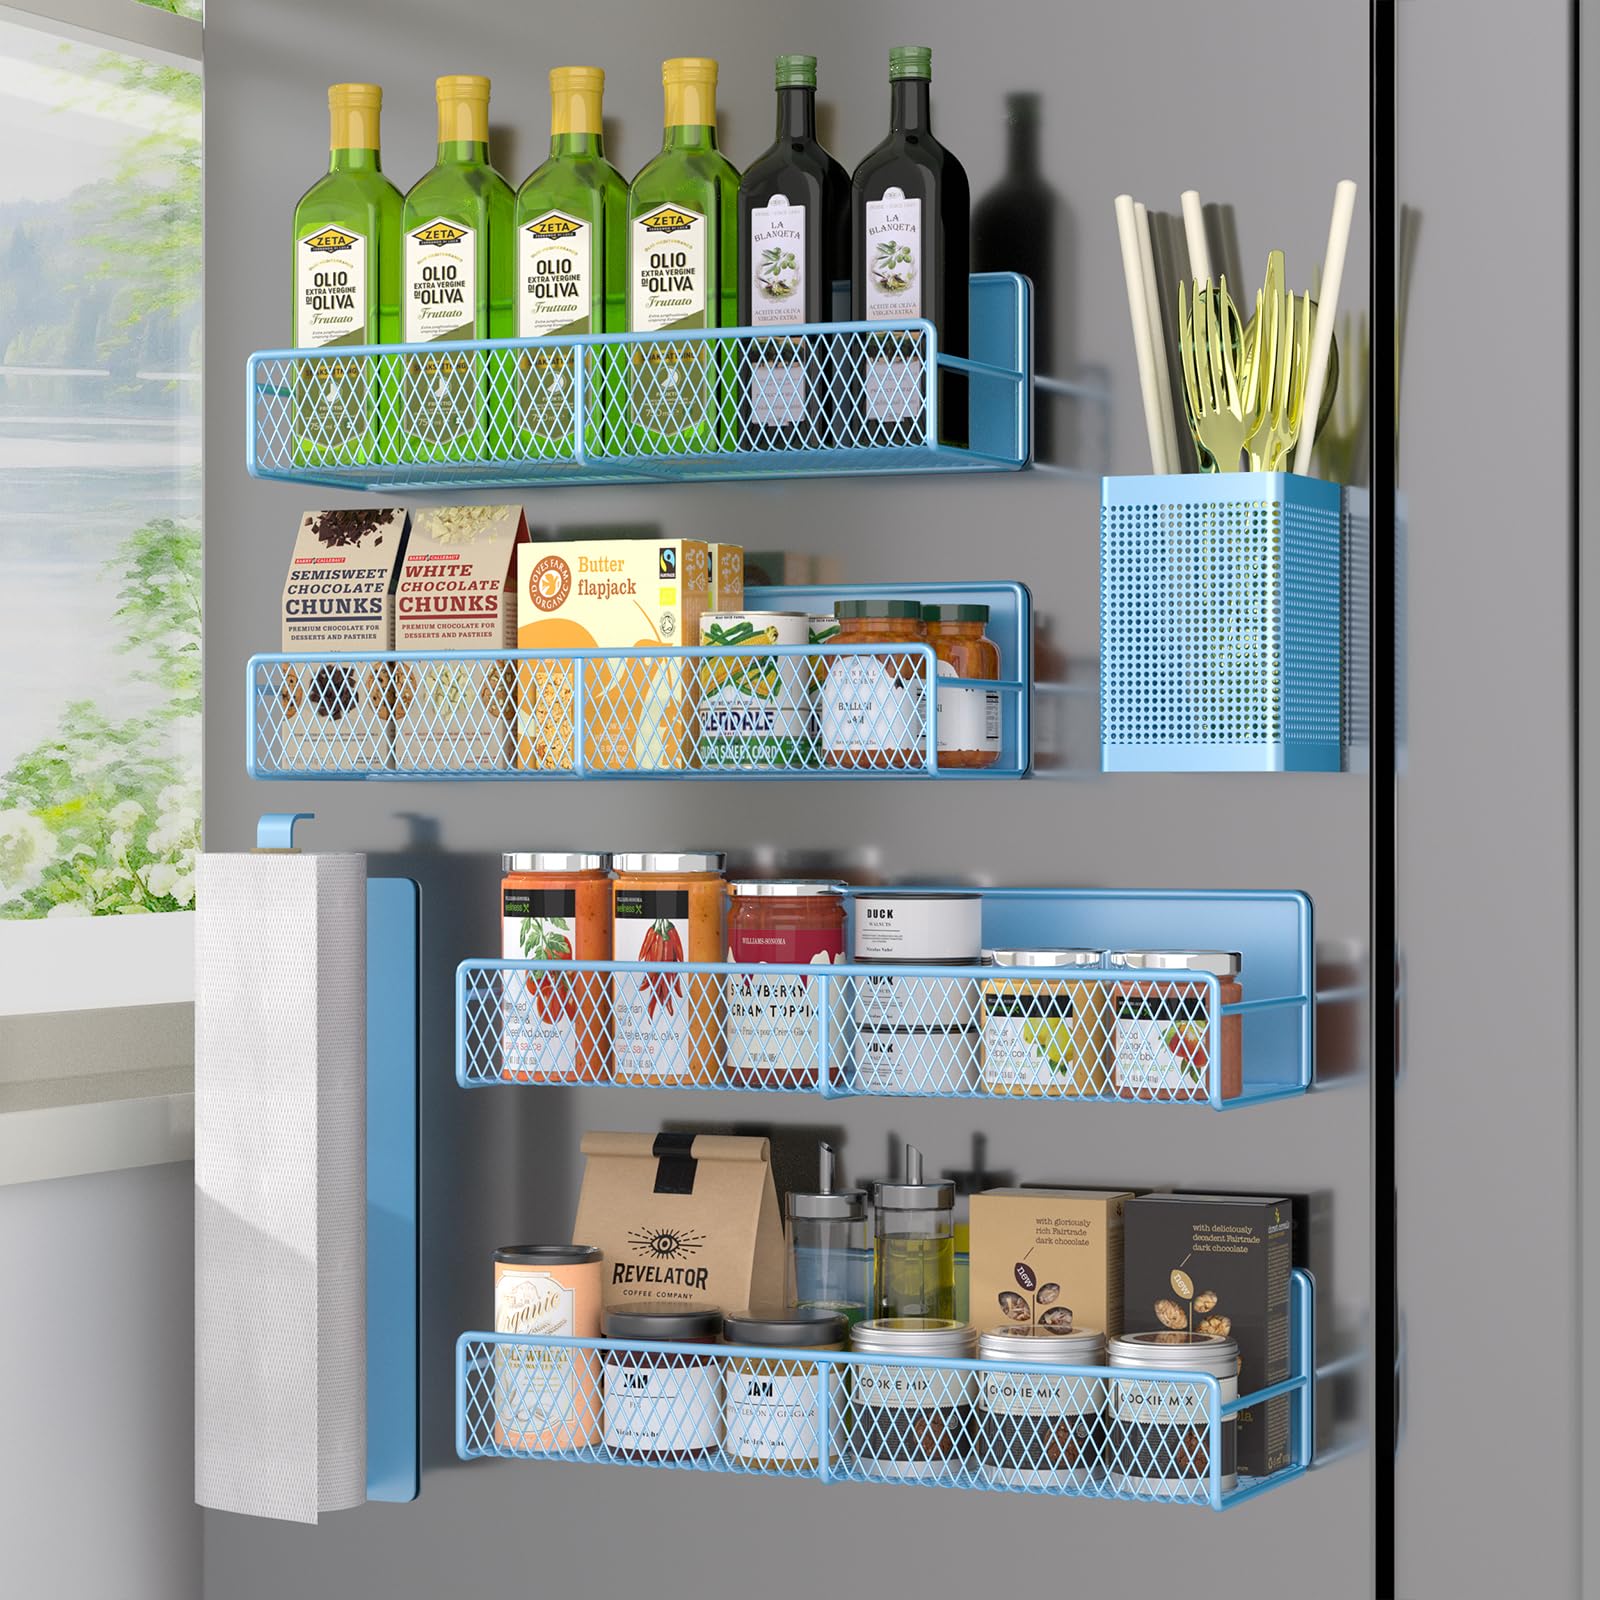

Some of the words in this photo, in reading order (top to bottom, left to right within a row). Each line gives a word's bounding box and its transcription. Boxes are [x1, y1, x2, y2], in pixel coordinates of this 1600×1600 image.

[539, 222, 570, 232] ZETA
[653, 216, 684, 225] ZETA
[426, 230, 455, 239] ZETA
[754, 230, 800, 242] BLANQETA
[869, 224, 916, 236] BLANQETA
[317, 237, 346, 245] ZETA
[536, 259, 571, 274] OLIO
[650, 253, 686, 268] OLIO
[314, 272, 347, 287] OLIO
[422, 266, 457, 280] OLIO
[535, 283, 579, 298] OLIVA
[649, 276, 693, 292] OLIVA
[313, 295, 354, 310] OLIVA
[421, 289, 463, 304] OLIVA
[647, 296, 692, 308] Fruttato
[418, 308, 462, 320] Fruttato
[532, 302, 578, 314] Fruttato
[310, 313, 353, 325] Fruttato
[405, 565, 472, 577] WHITE
[578, 556, 625, 572] Butter
[291, 569, 387, 580] SEMISWEET
[531, 560, 548, 592] DOVES
[550, 559, 569, 580] FARM
[288, 583, 384, 595] CHOCOLATE
[401, 580, 500, 592] CHOCOLATE
[578, 578, 636, 600] flapjack
[536, 584, 568, 609] ORGANIC
[286, 598, 382, 615] CHUNKS
[400, 596, 497, 612] CHUNKS
[867, 908, 894, 919] DUCK
[1054, 1219, 1091, 1227] gloriously
[1212, 1225, 1252, 1234] deliciously
[612, 1262, 708, 1290] REVELATOR
[1017, 1266, 1033, 1287] new
[1174, 1274, 1190, 1295] new
[623, 1289, 652, 1298] COFFEE
[656, 1291, 694, 1300] COMPANY
[496, 1291, 560, 1334] rganic
[624, 1374, 648, 1388] JAM
[860, 1376, 902, 1390] COOKE
[748, 1382, 773, 1397] JAM
[1169, 1396, 1193, 1406] MX
